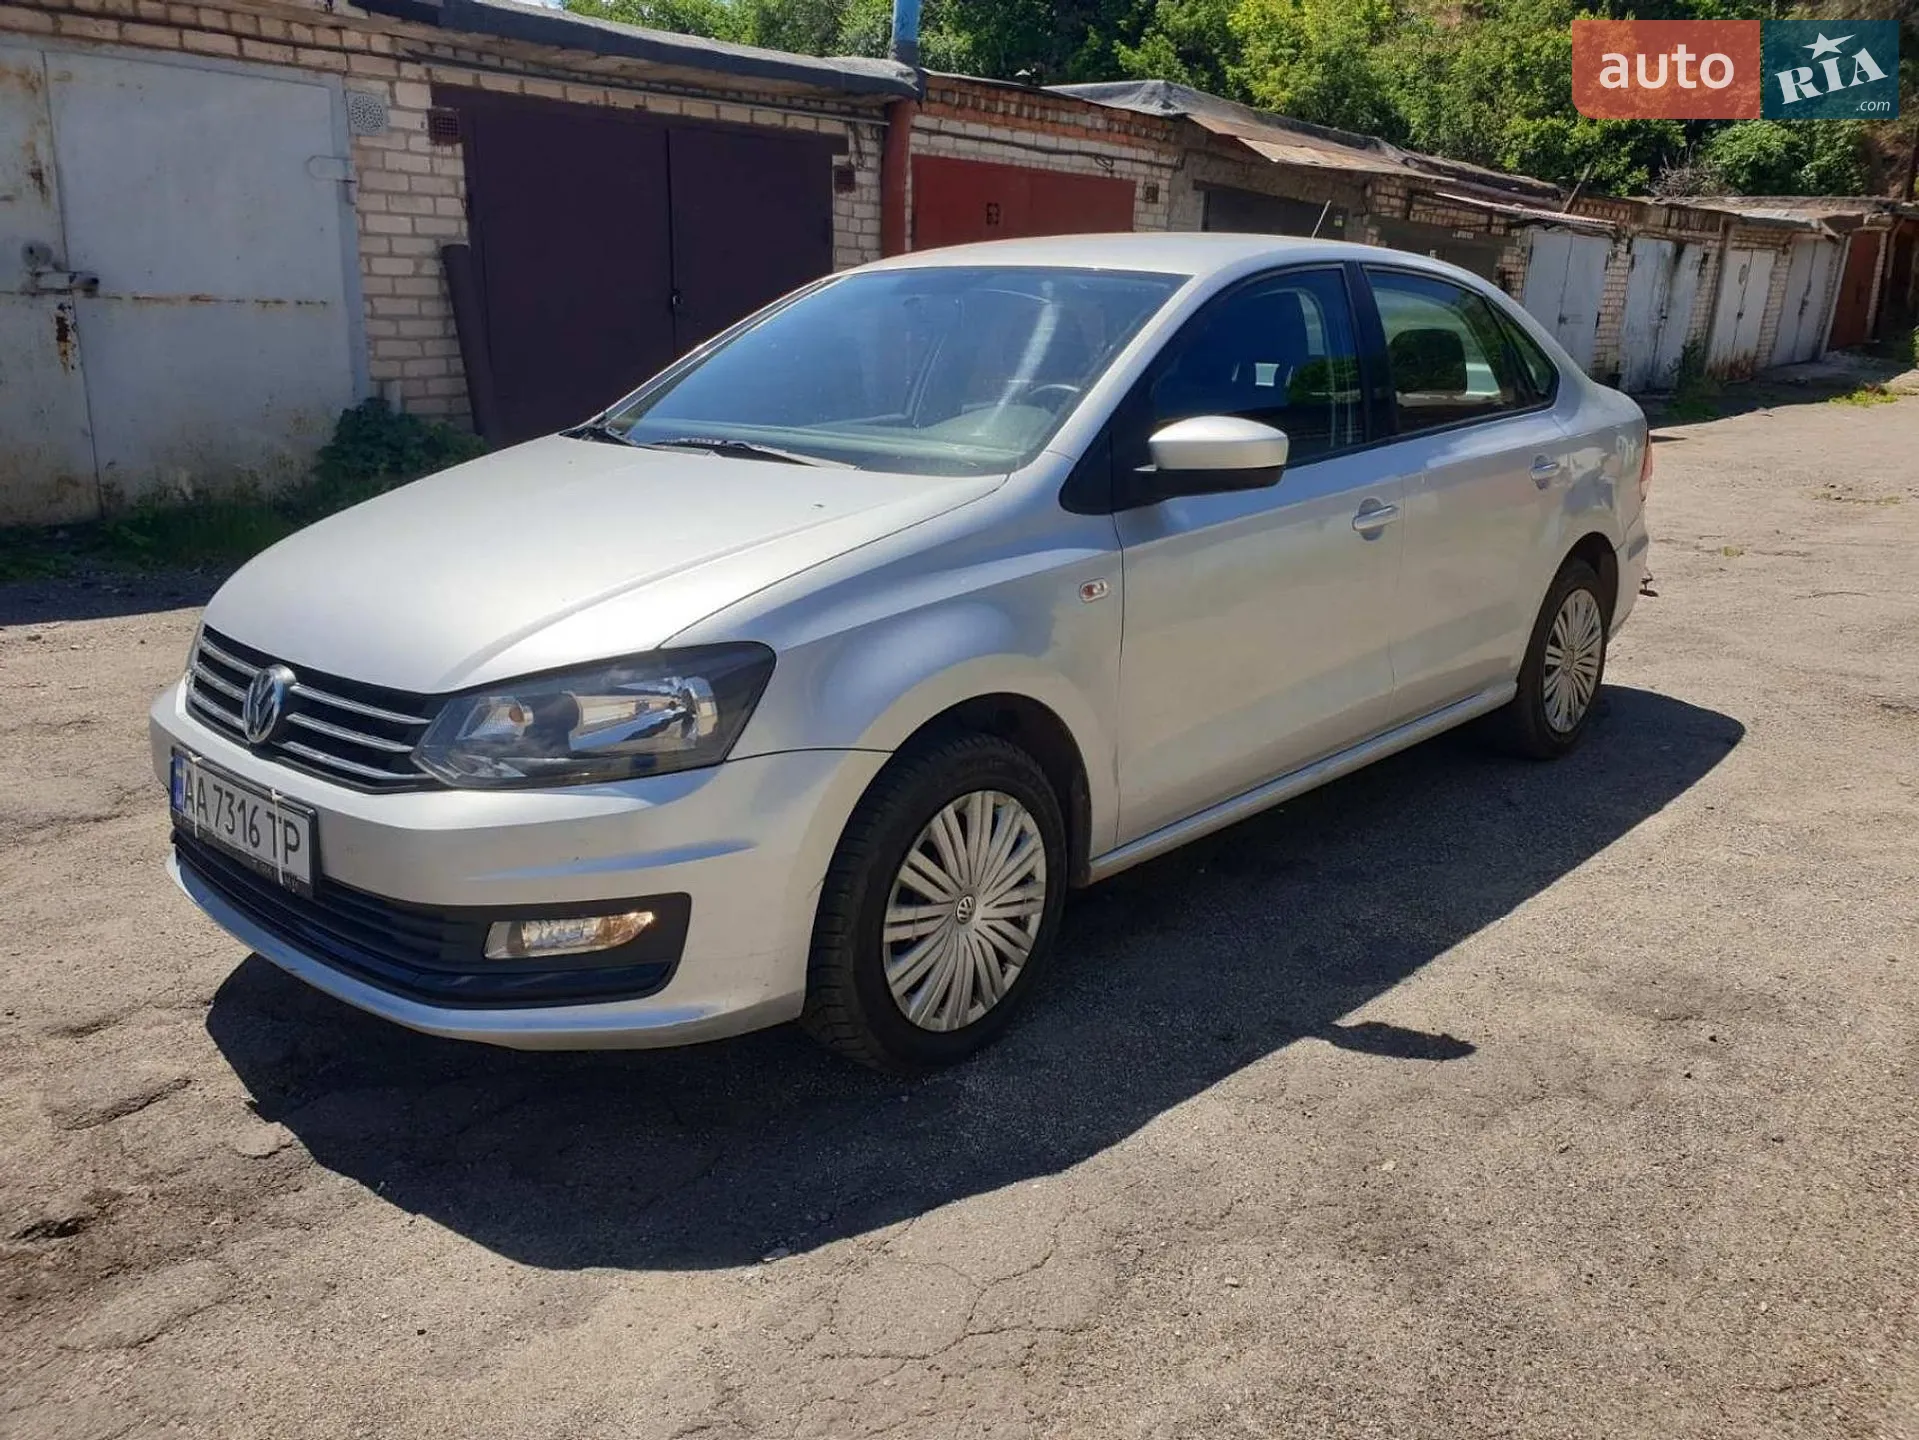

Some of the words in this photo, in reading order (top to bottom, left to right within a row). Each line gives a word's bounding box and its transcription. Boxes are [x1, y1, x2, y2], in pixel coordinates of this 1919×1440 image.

[184, 769, 208, 822] AA
[213, 784, 260, 848] 7316
[266, 811, 300, 864] TP
